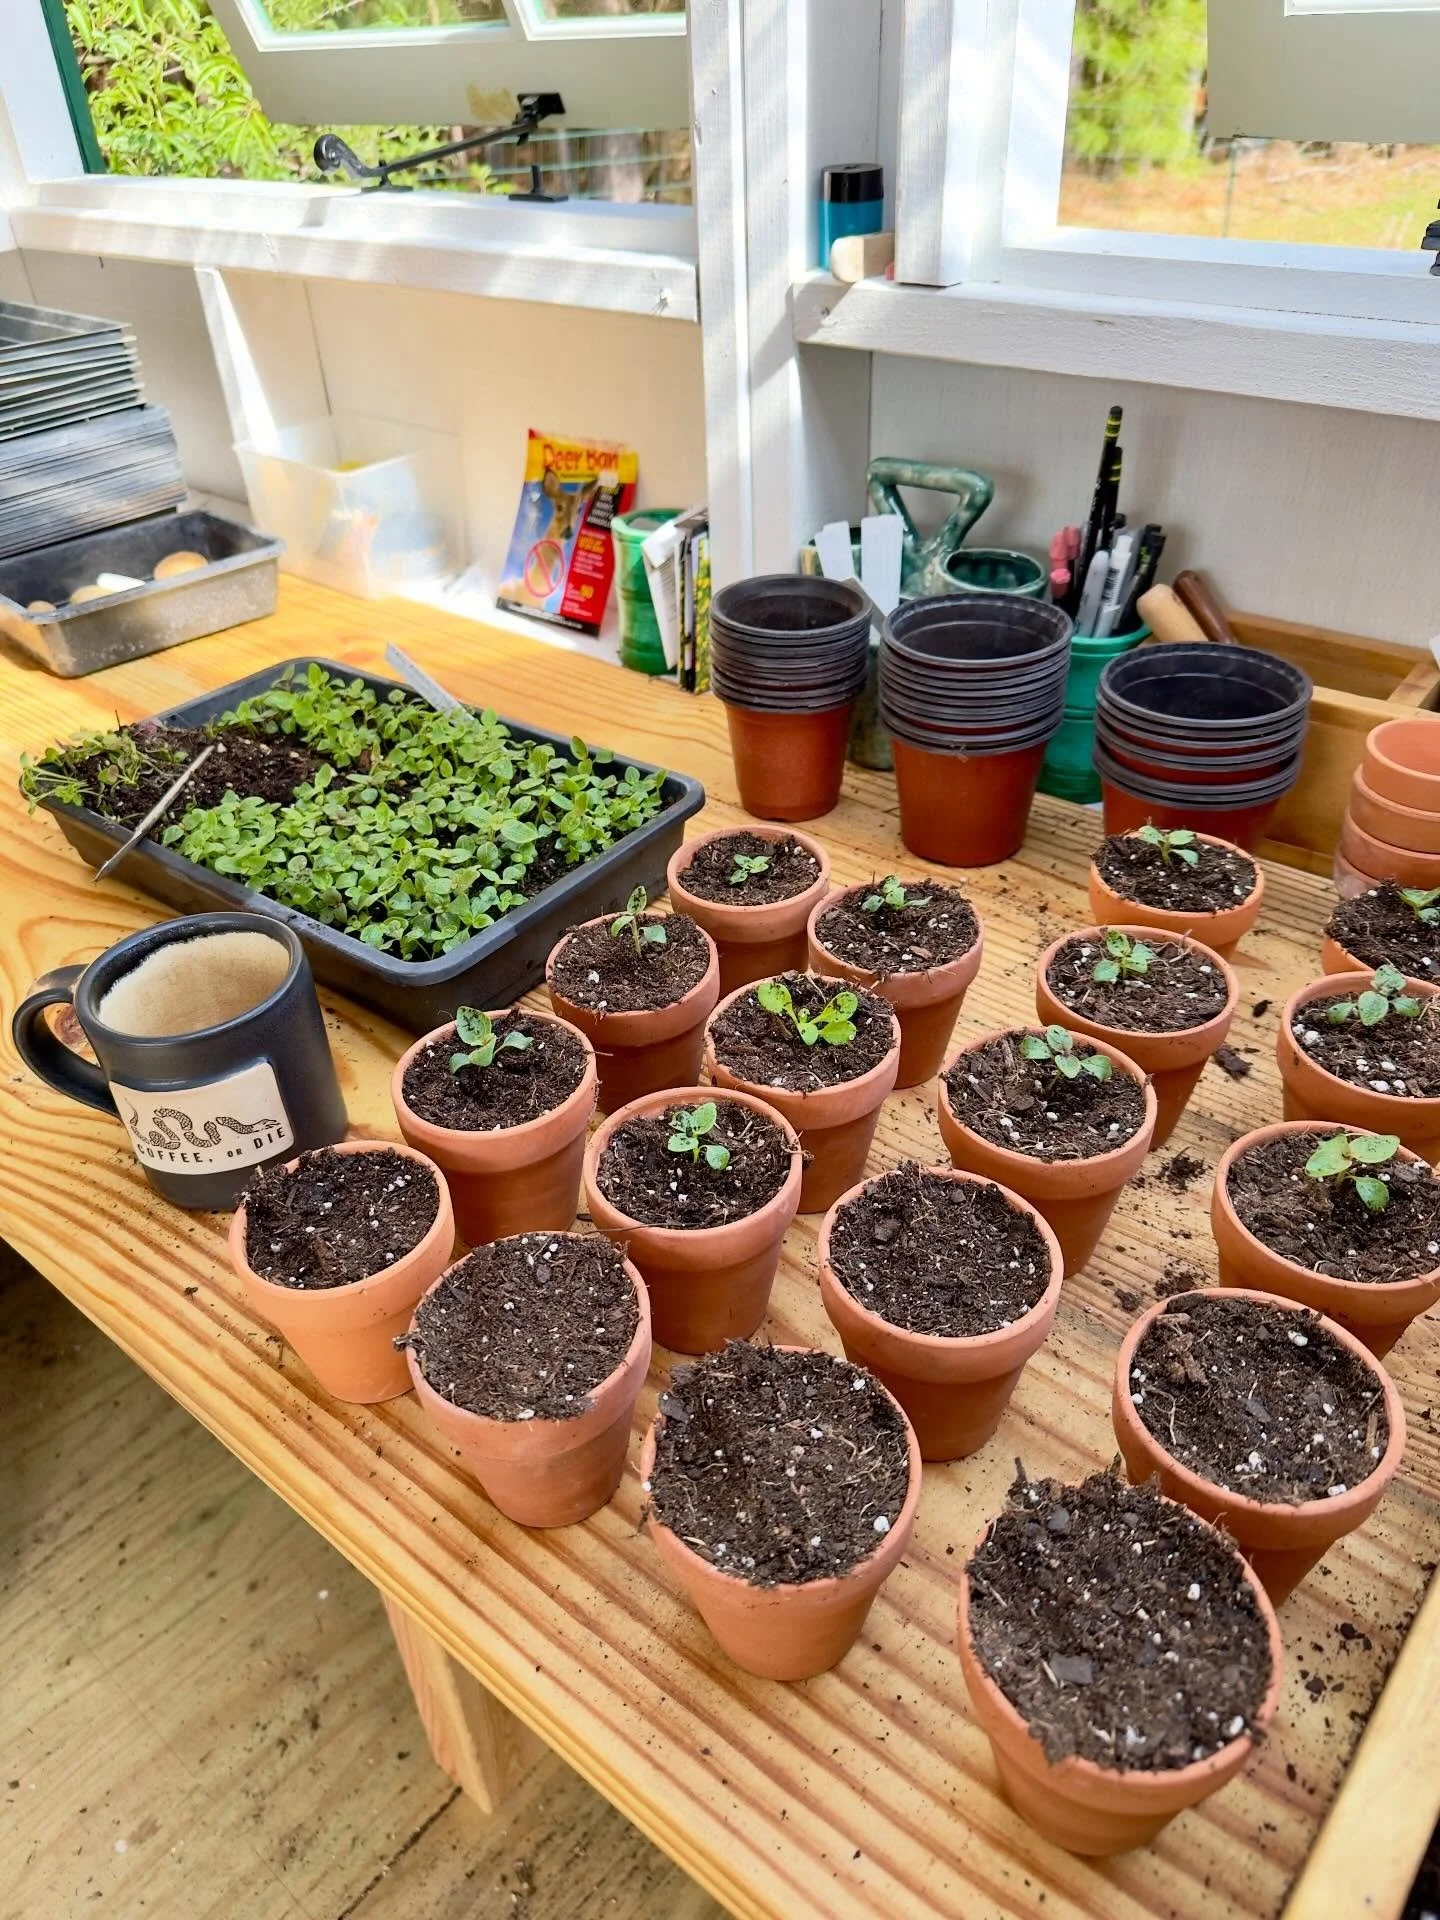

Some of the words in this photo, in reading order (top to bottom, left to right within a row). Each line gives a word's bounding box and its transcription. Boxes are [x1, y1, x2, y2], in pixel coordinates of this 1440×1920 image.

[543, 443, 582, 471] Deer
[227, 1148, 243, 1158] OR
[253, 1127, 286, 1150] DIE
